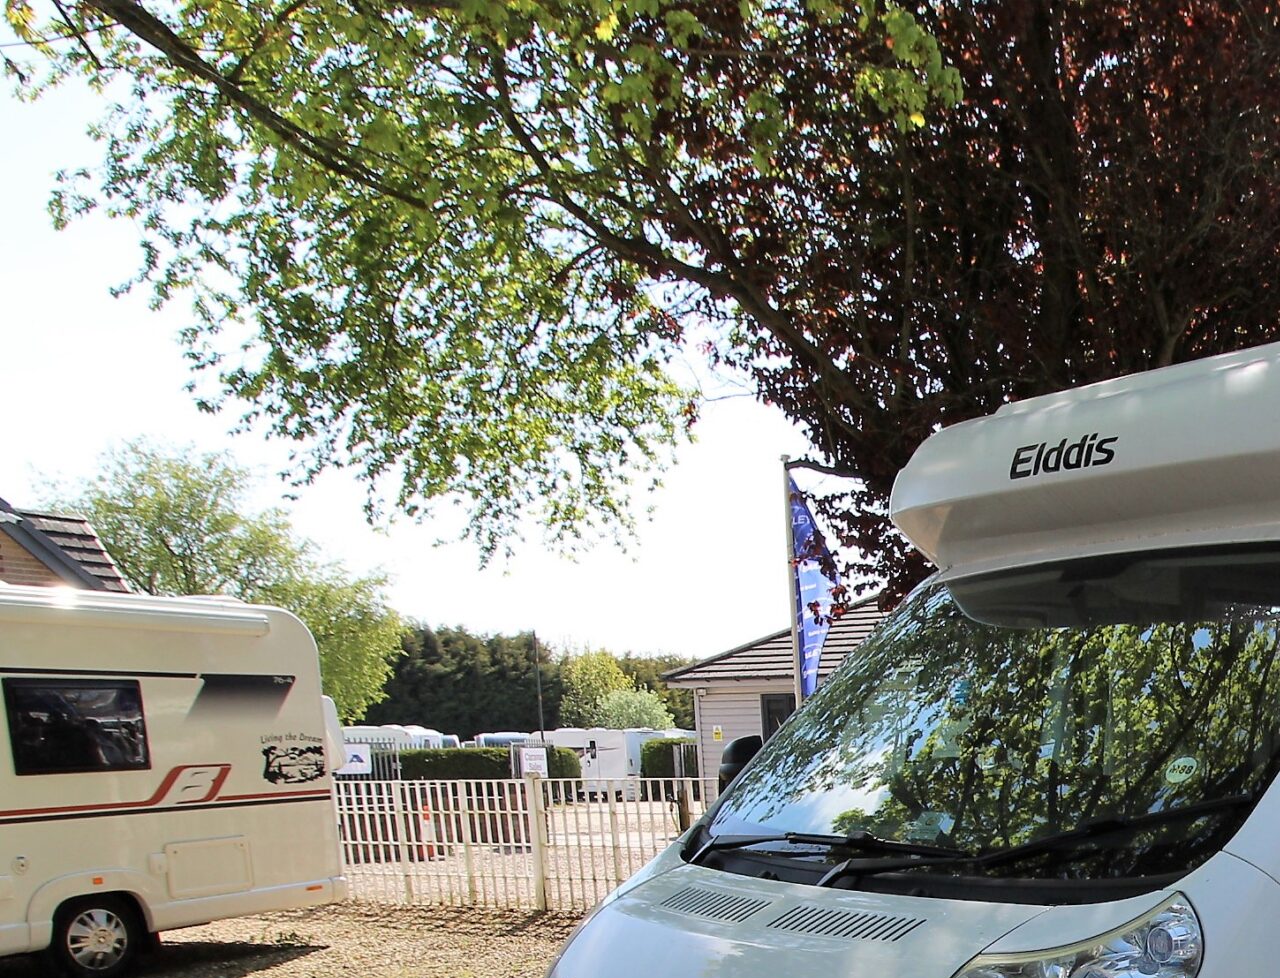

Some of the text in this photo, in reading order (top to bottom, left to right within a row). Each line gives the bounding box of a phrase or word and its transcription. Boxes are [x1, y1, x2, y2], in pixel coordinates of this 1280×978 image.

[1010, 433, 1119, 479] Elddis
[260, 735, 283, 744] Living
[285, 731, 297, 741] the
